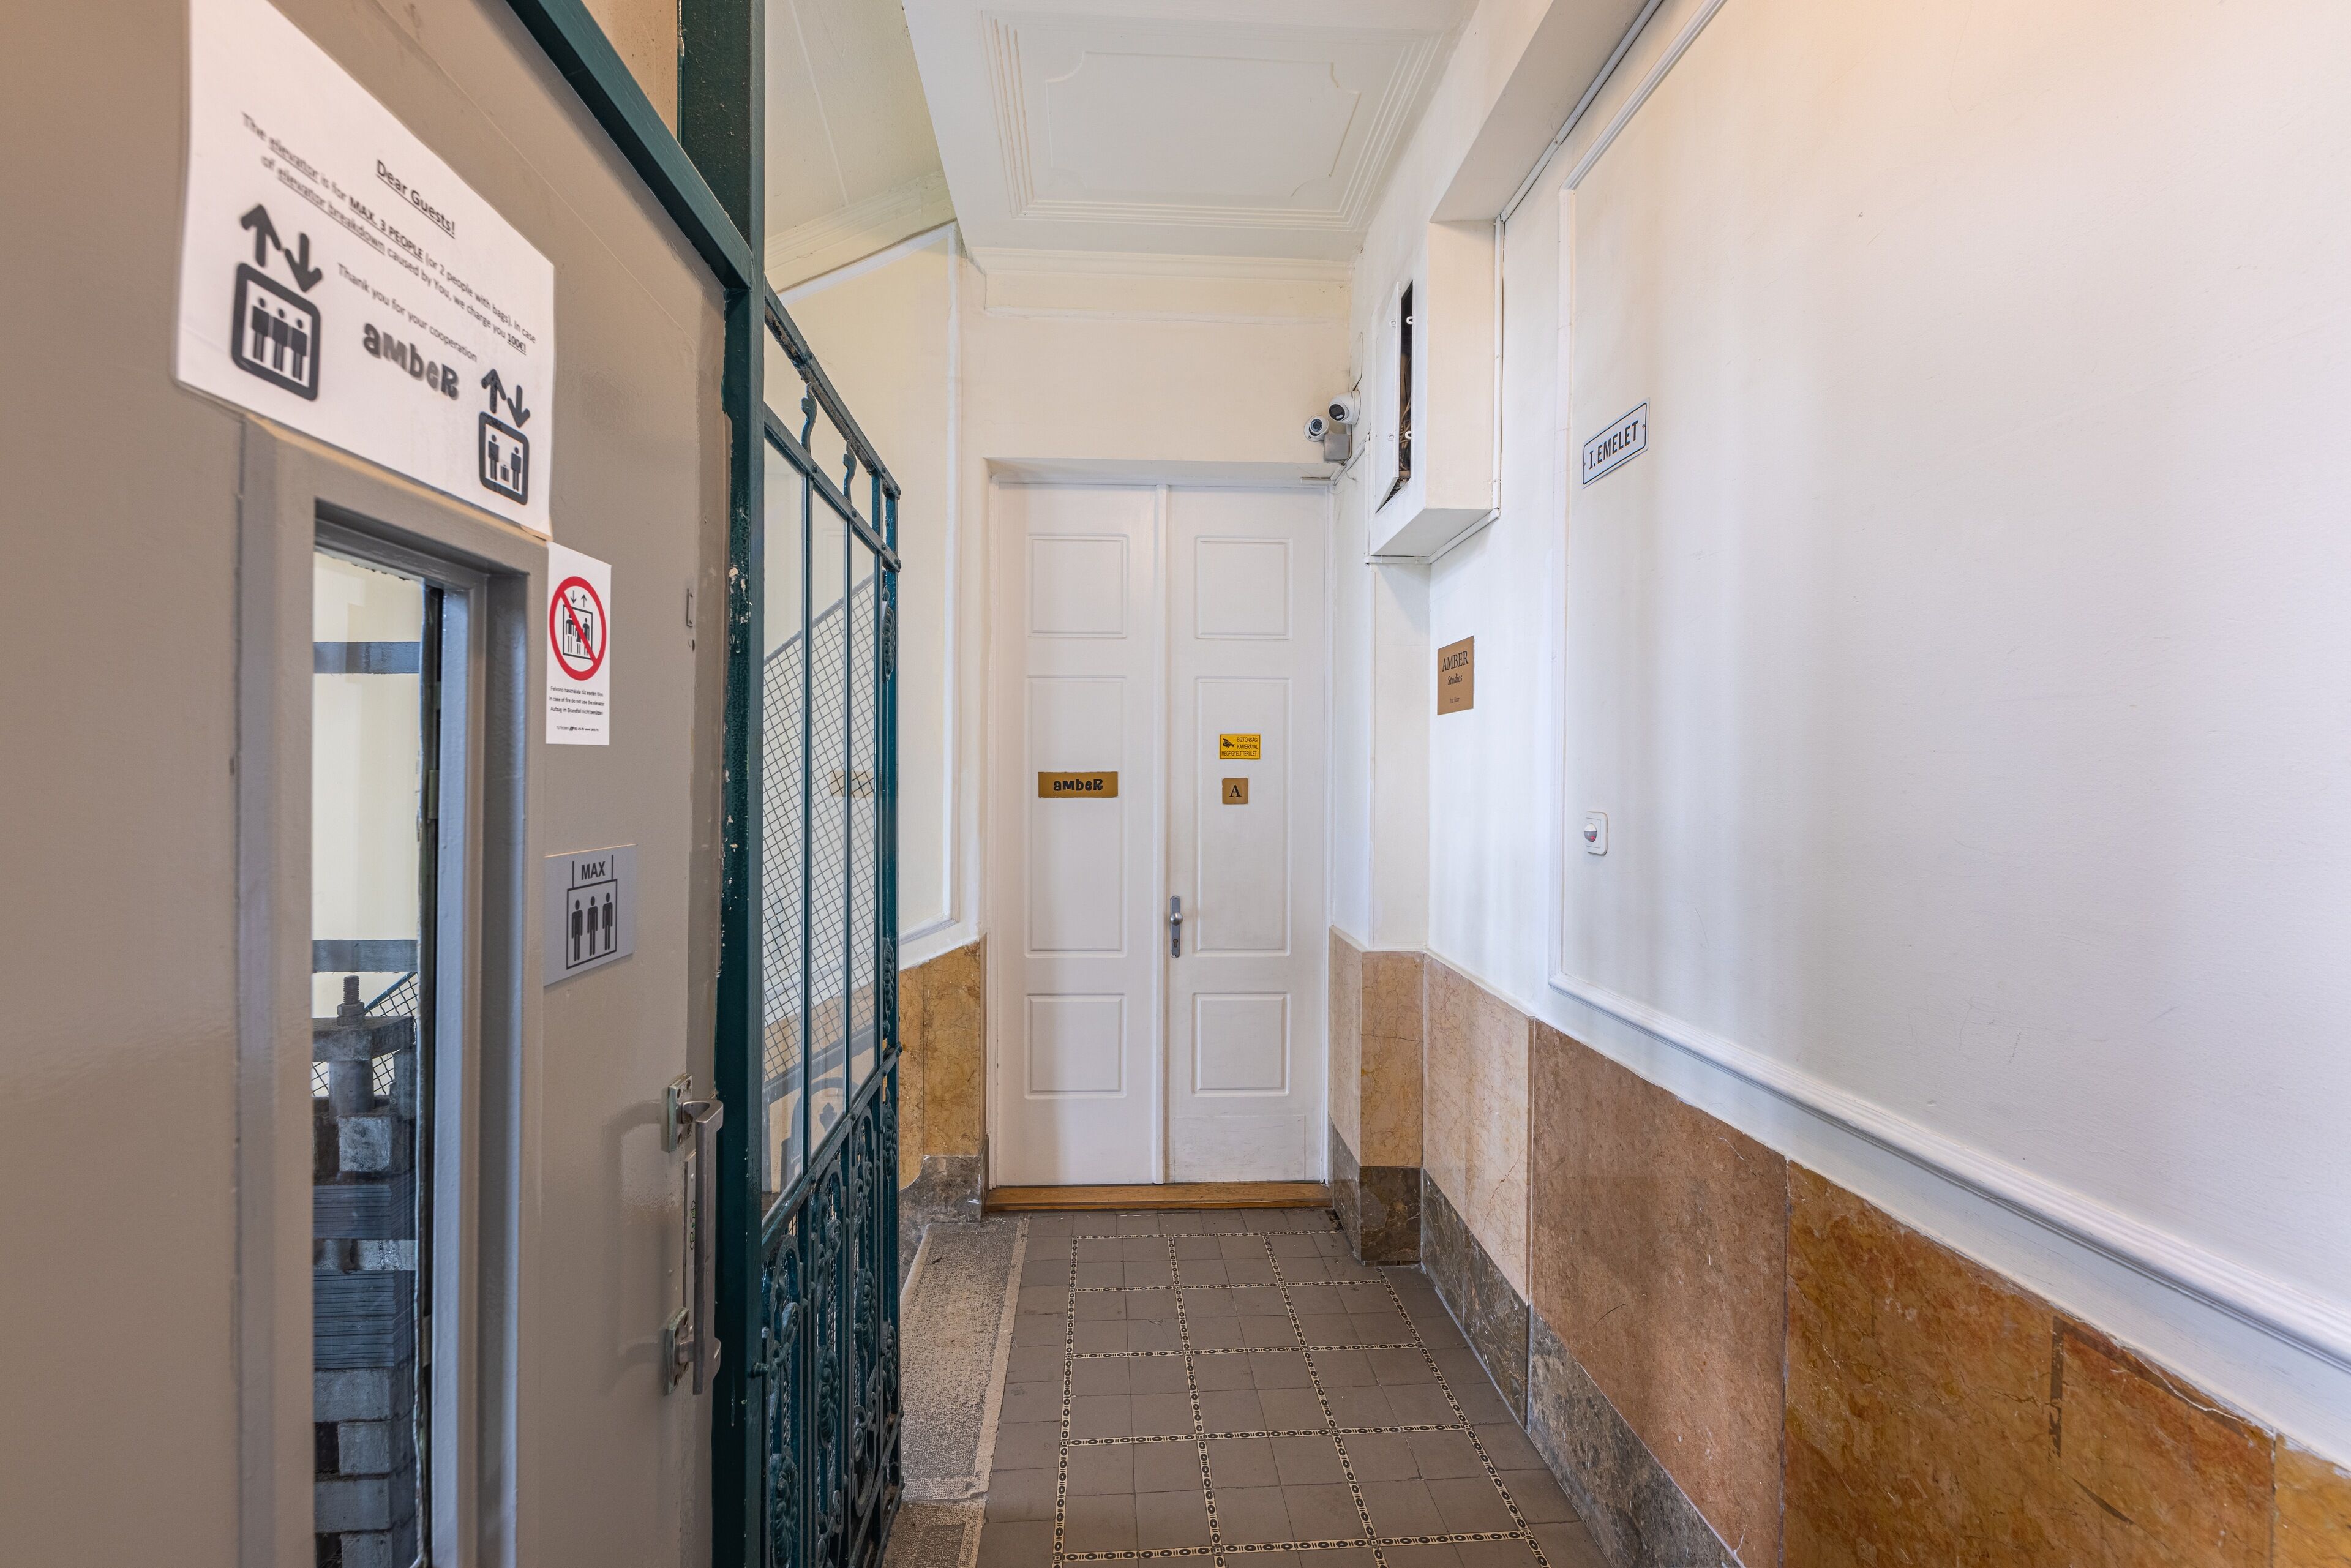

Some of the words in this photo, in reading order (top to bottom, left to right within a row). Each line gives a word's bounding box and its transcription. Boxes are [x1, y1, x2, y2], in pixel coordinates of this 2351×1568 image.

[377, 159, 407, 195] Dear
[411, 189, 456, 235] Guests!
[242, 111, 266, 141] The
[268, 137, 318, 180] elevator
[320, 172, 329, 189] is
[331, 182, 347, 201] for
[349, 195, 377, 226] MAX.
[380, 219, 386, 231] 3
[388, 225, 424, 260] PEOPLE
[425, 252, 438, 269] (or
[439, 264, 445, 276] 2
[446, 272, 473, 297] people
[474, 292, 491, 310] with
[492, 304, 512, 326] bags).
[522, 328, 536, 343] case
[261, 155, 275, 171] of
[277, 167, 325, 207] elevator
[328, 201, 386, 253] breakdown
[387, 247, 419, 276] caused
[421, 269, 432, 287] by
[433, 278, 451, 301] You,
[453, 295, 465, 309] we
[467, 304, 491, 328] charge
[492, 324, 506, 338] you
[337, 262, 369, 293] Thank
[371, 288, 390, 306] you
[391, 299, 406, 315] for
[407, 311, 428, 330] your
[429, 325, 477, 362] cooperation
[1442, 650, 1469, 672] AMBER
[1447, 673, 1463, 685] Studios
[1229, 784, 1242, 797] A
[581, 861, 606, 880] MAX
